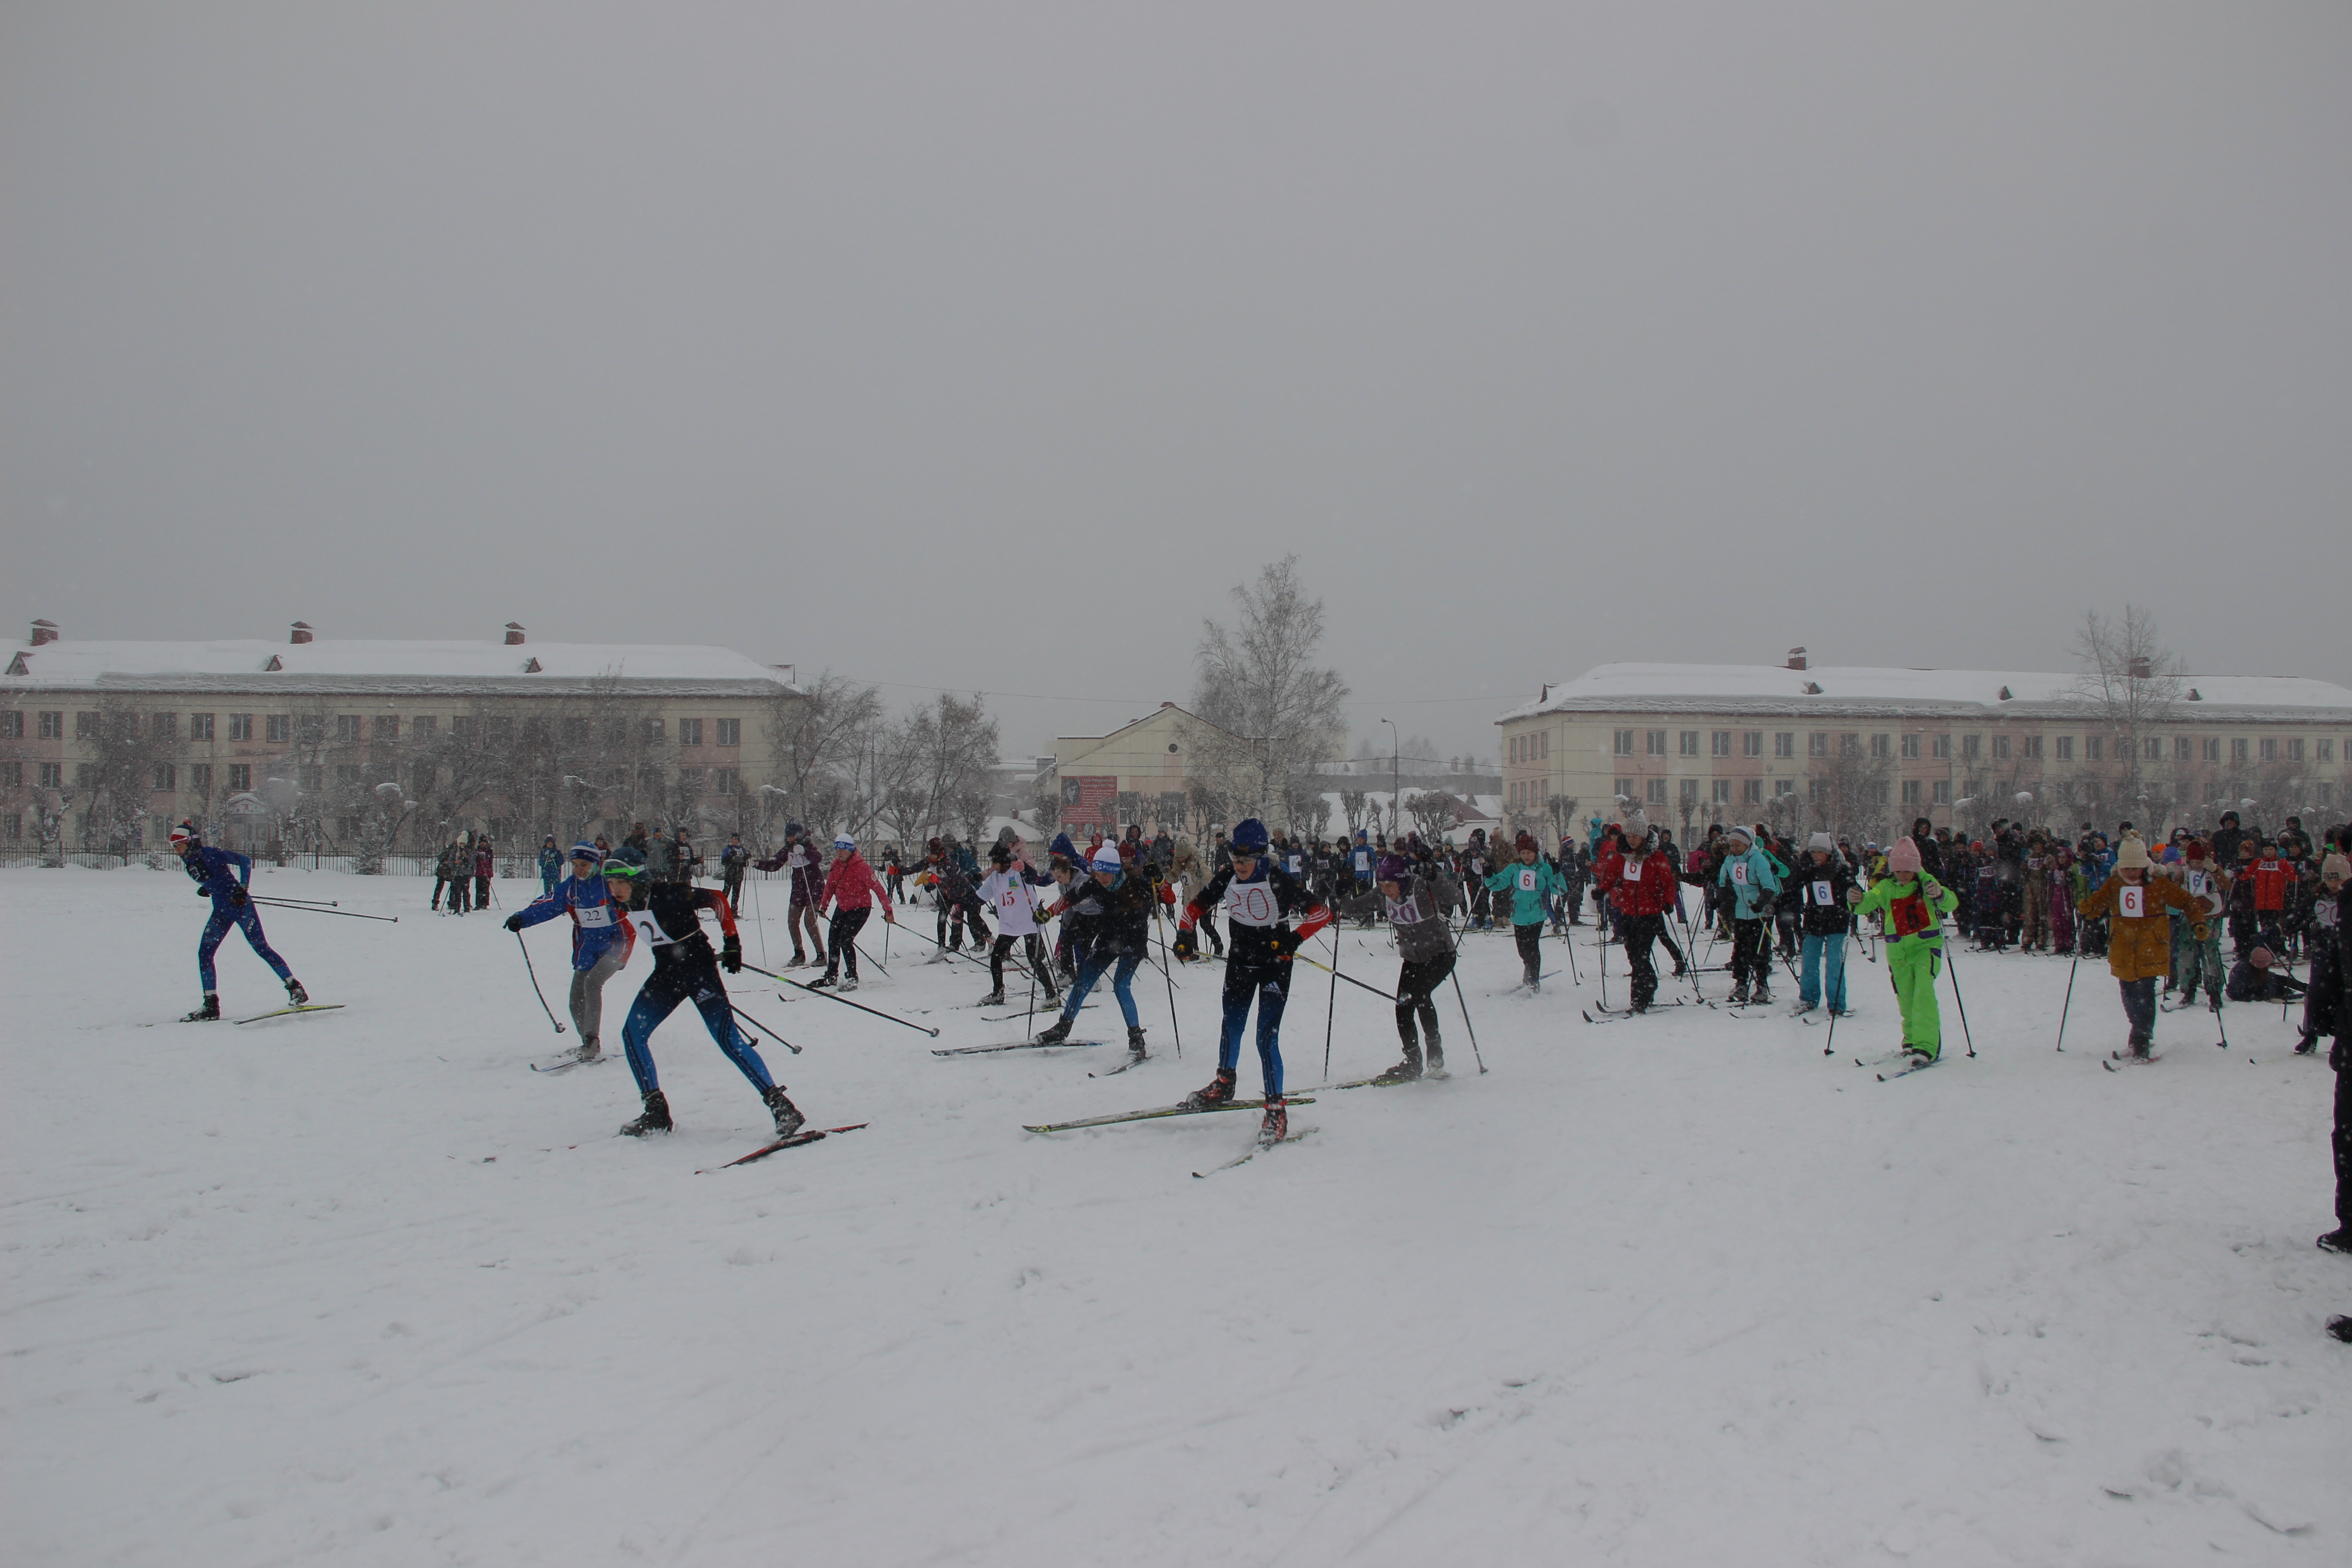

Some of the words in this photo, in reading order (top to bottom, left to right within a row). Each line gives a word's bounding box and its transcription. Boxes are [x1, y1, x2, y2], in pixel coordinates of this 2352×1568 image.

[1357, 856, 1364, 866] 6
[1736, 866, 1742, 879] 6
[1523, 874, 1530, 887] 6
[2193, 874, 2201, 887] 6
[1001, 891, 1015, 906] 15
[1818, 886, 1827, 899] 6
[1230, 888, 1269, 920] 20
[2125, 892, 2136, 910] 6
[584, 910, 602, 921] 22
[1387, 904, 1416, 923] 20
[1906, 904, 1920, 929] 6
[640, 921, 665, 942] 2
